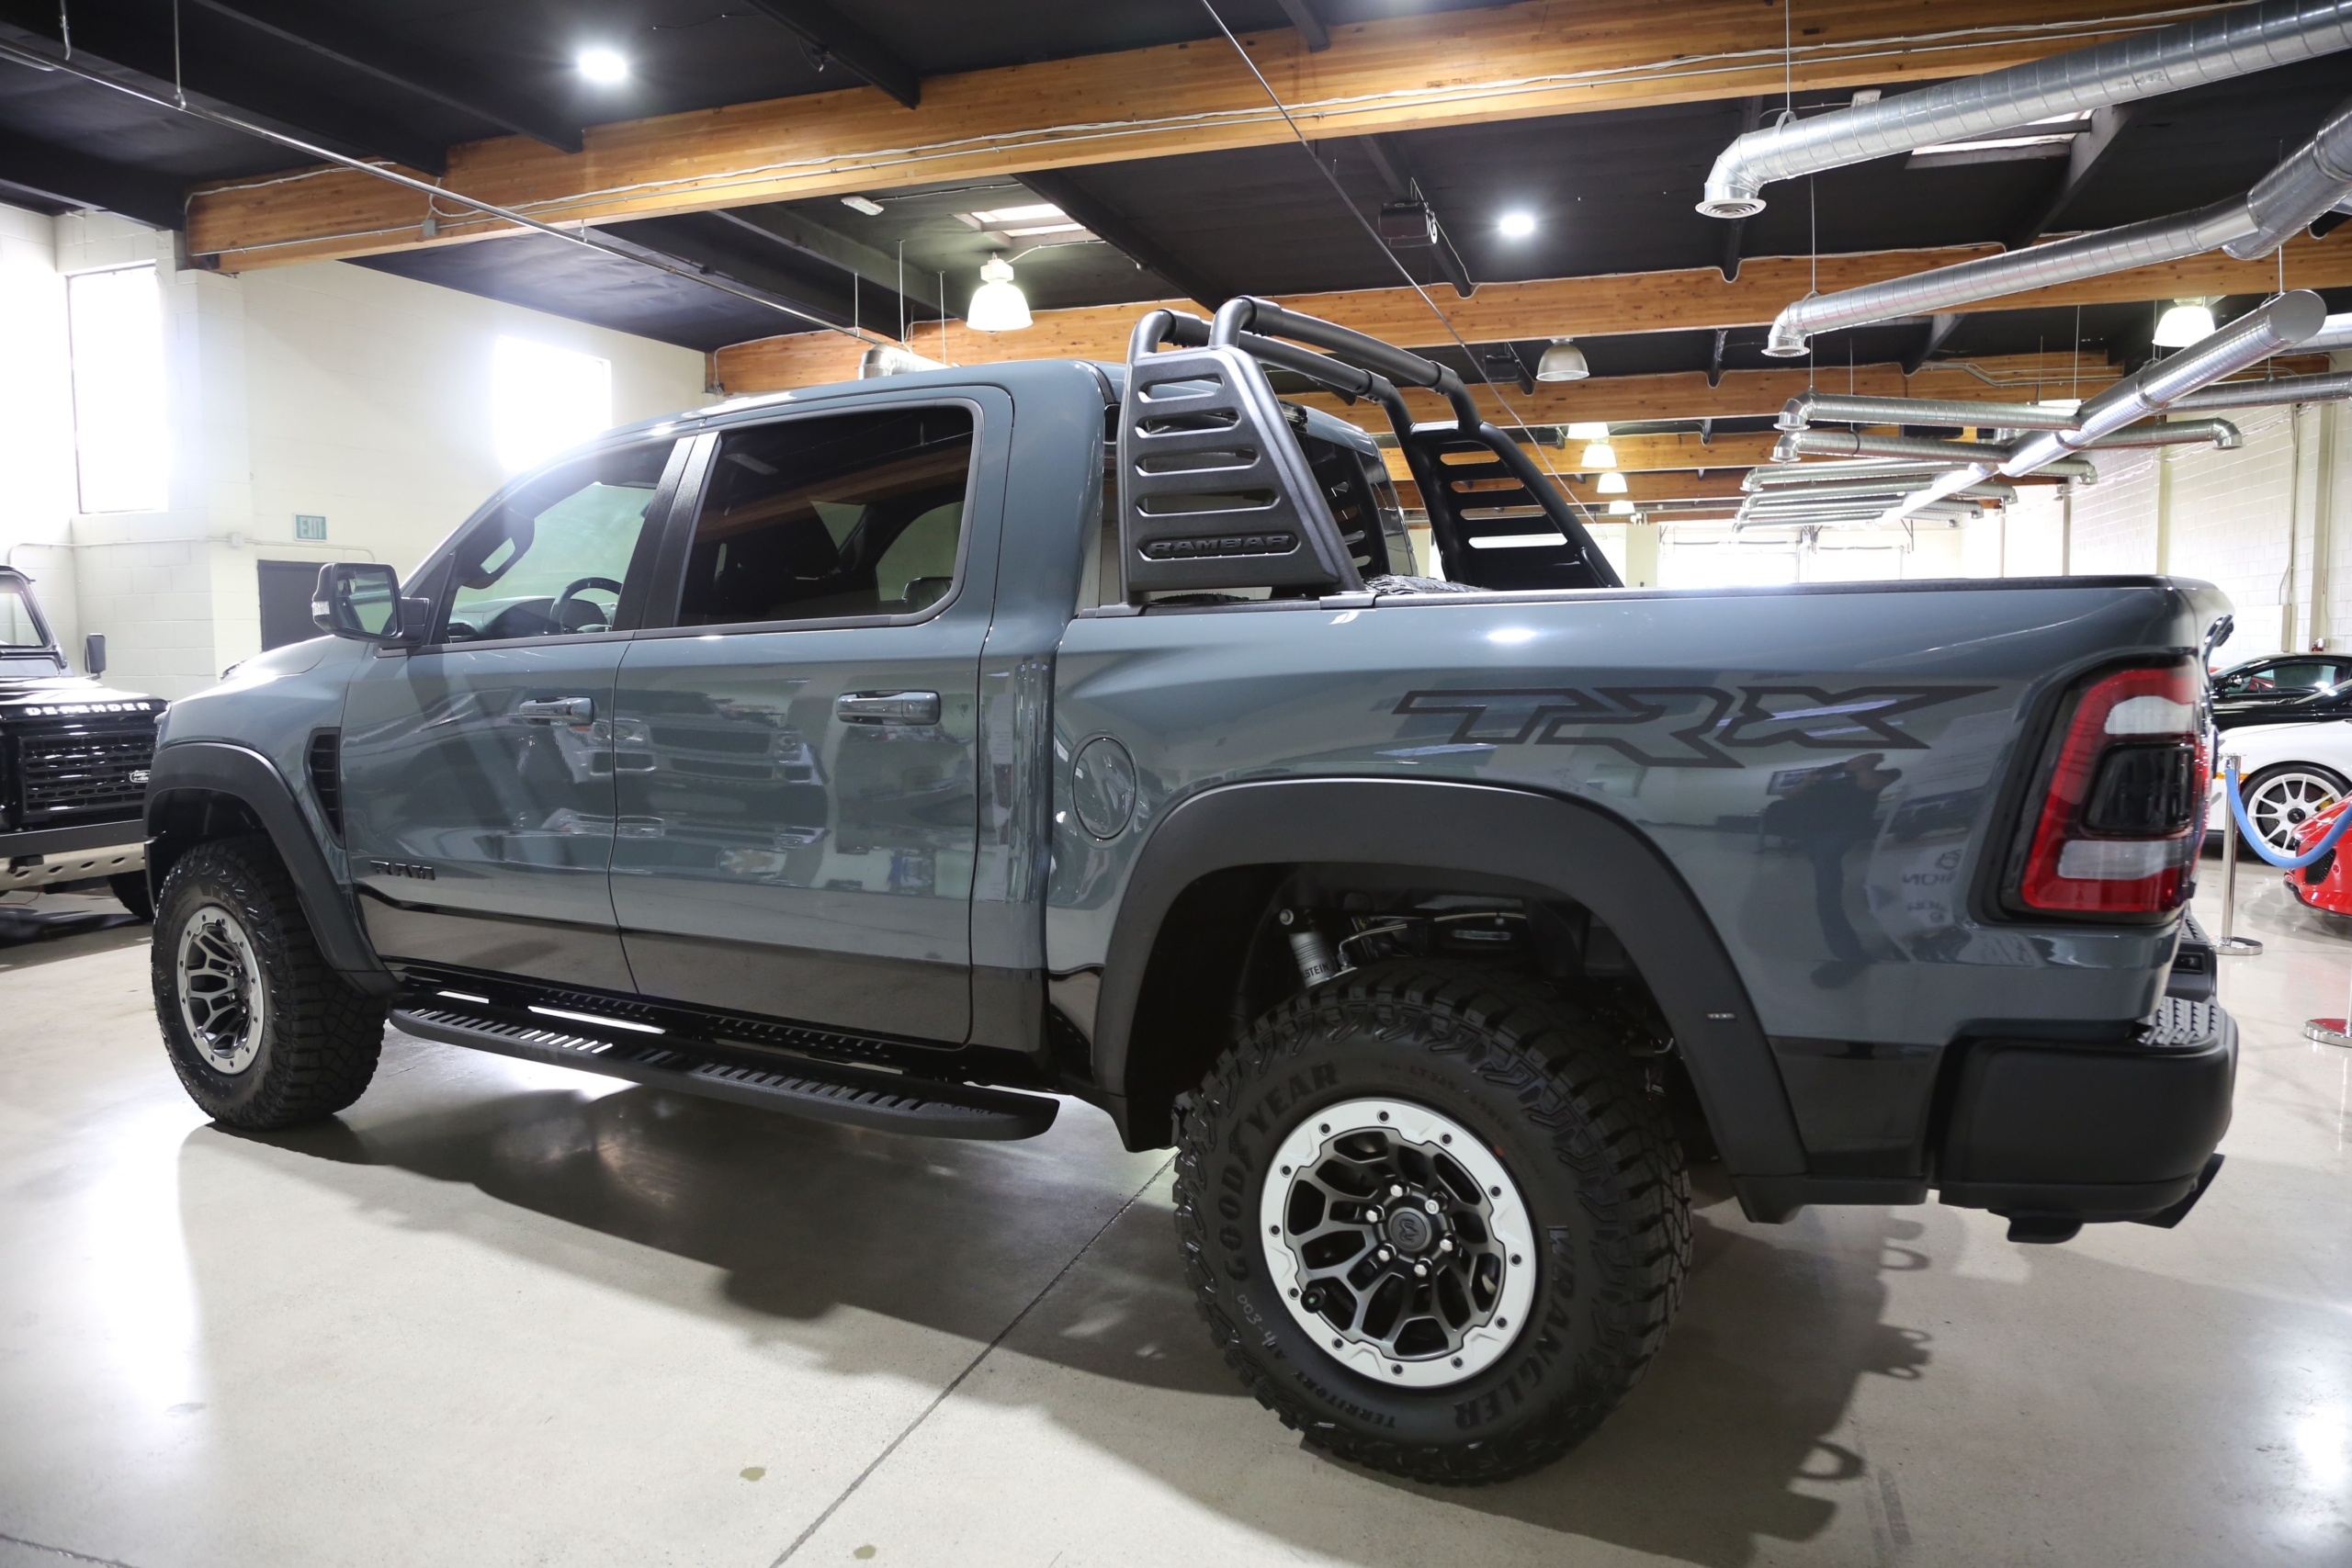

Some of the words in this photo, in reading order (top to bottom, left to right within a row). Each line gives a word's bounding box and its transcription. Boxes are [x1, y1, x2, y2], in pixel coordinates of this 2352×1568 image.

[300, 516, 323, 538] EXIT
[1148, 535, 1290, 554] RAMBAR
[25, 702, 152, 716] DEFENDER
[1392, 686, 2000, 768] TRX
[370, 860, 435, 880] RAM
[1303, 963, 1329, 979] LSTEIN
[1453, 1225, 1576, 1431] WRANGLER
[1291, 1371, 1396, 1428] TERRITORY
